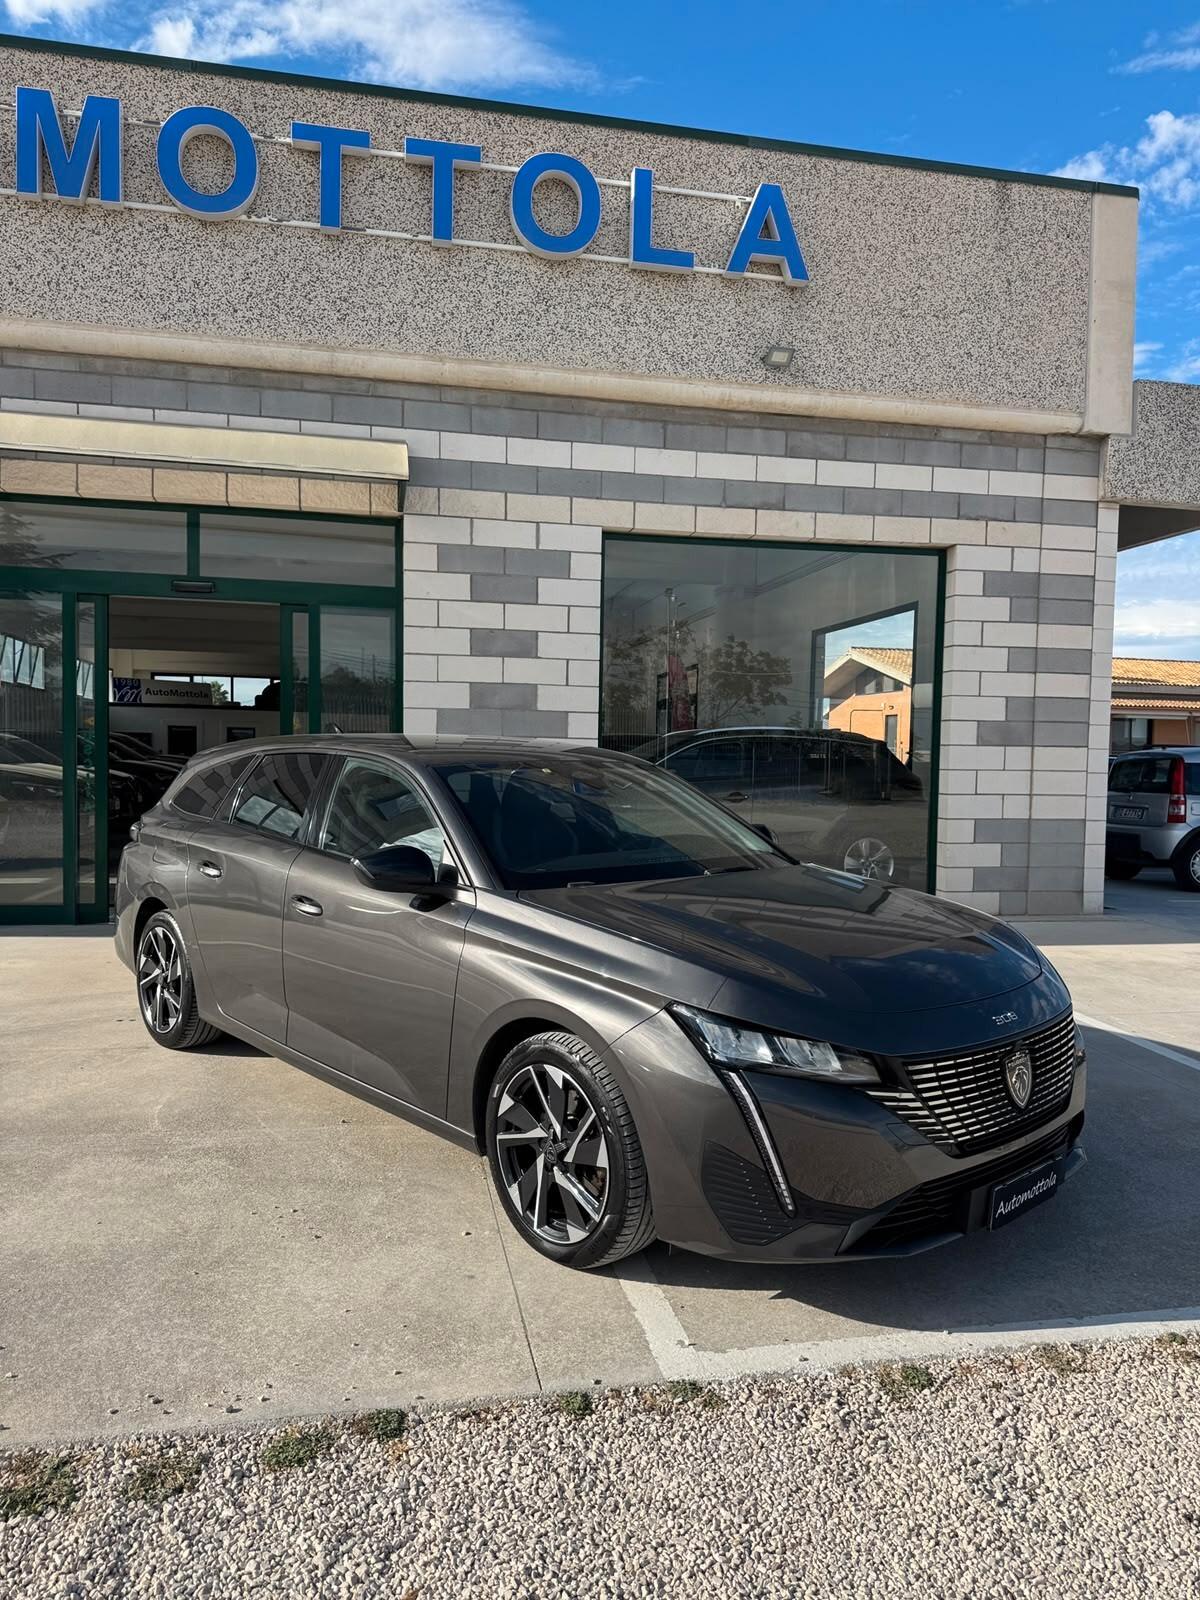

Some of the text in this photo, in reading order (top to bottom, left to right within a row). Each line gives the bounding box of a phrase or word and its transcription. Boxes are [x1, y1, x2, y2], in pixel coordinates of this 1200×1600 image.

[15, 86, 810, 288] MOTTOLA
[146, 688, 209, 699] AutoMottola
[992, 1010, 1018, 1025] 308
[995, 1171, 1057, 1219] Automottola
